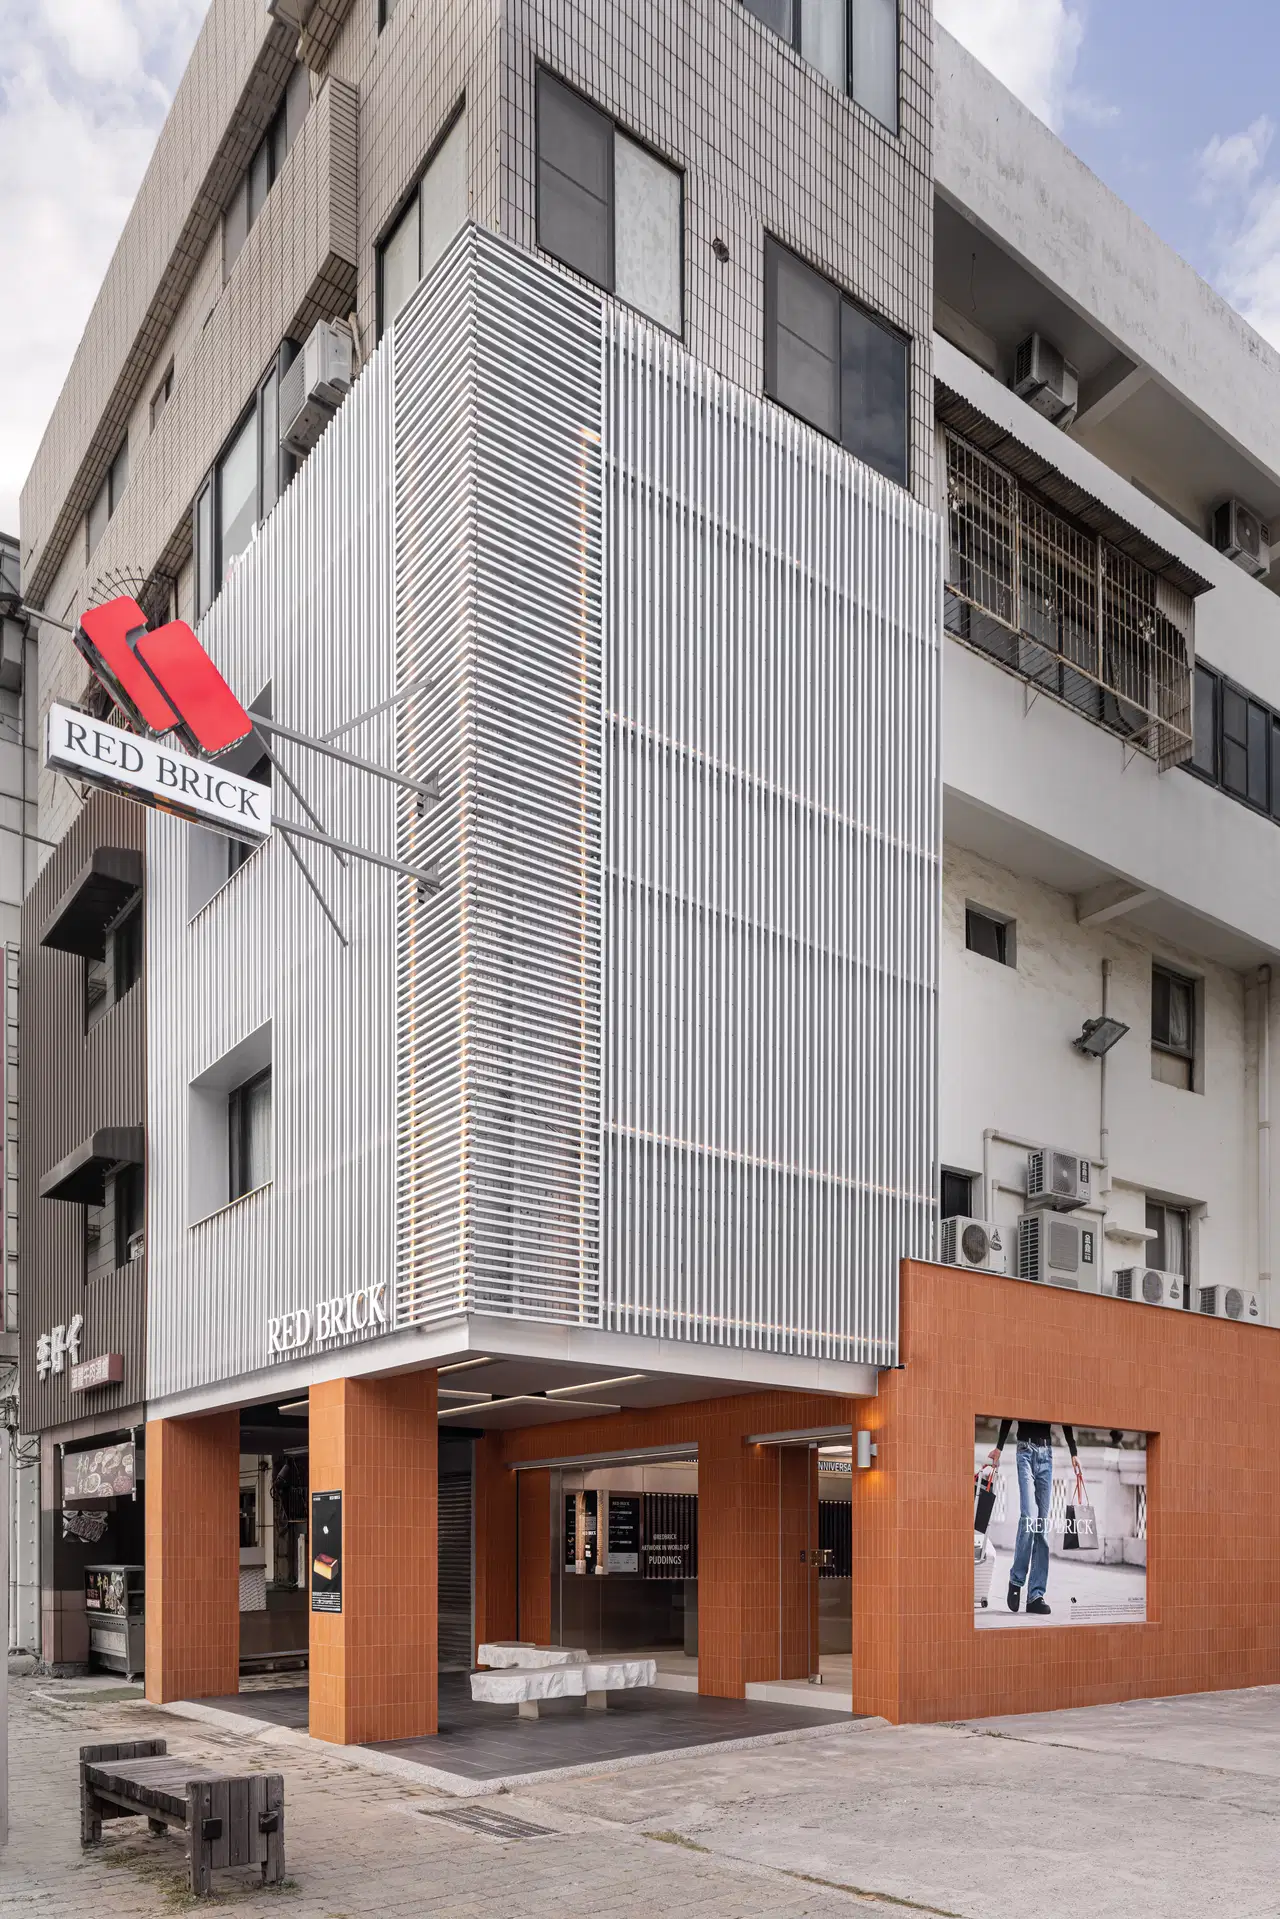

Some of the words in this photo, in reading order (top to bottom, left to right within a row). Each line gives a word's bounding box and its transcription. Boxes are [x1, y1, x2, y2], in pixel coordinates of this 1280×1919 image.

[64, 719, 144, 773] RED
[156, 755, 261, 821] BRICK
[267, 1308, 312, 1355] RED
[315, 1281, 387, 1341] BRICK
[1025, 1516, 1052, 1533] RED
[1055, 1517, 1094, 1535] BRICK
[648, 1555, 682, 1565] PUDDINGS
